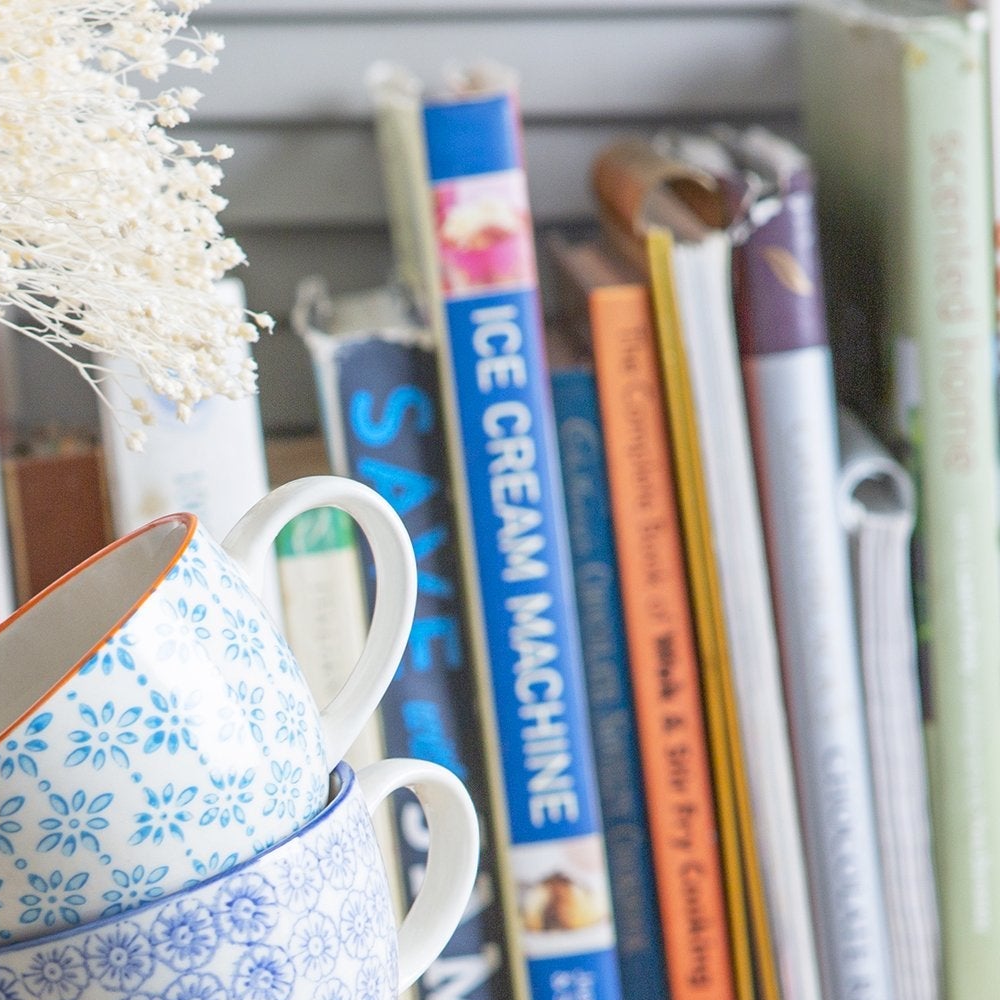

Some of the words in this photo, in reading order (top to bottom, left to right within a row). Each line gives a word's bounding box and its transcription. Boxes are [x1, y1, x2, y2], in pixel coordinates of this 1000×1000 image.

[469, 304, 528, 394] ICE
[482, 401, 550, 584] CREAM
[505, 591, 580, 829] MACHINE
